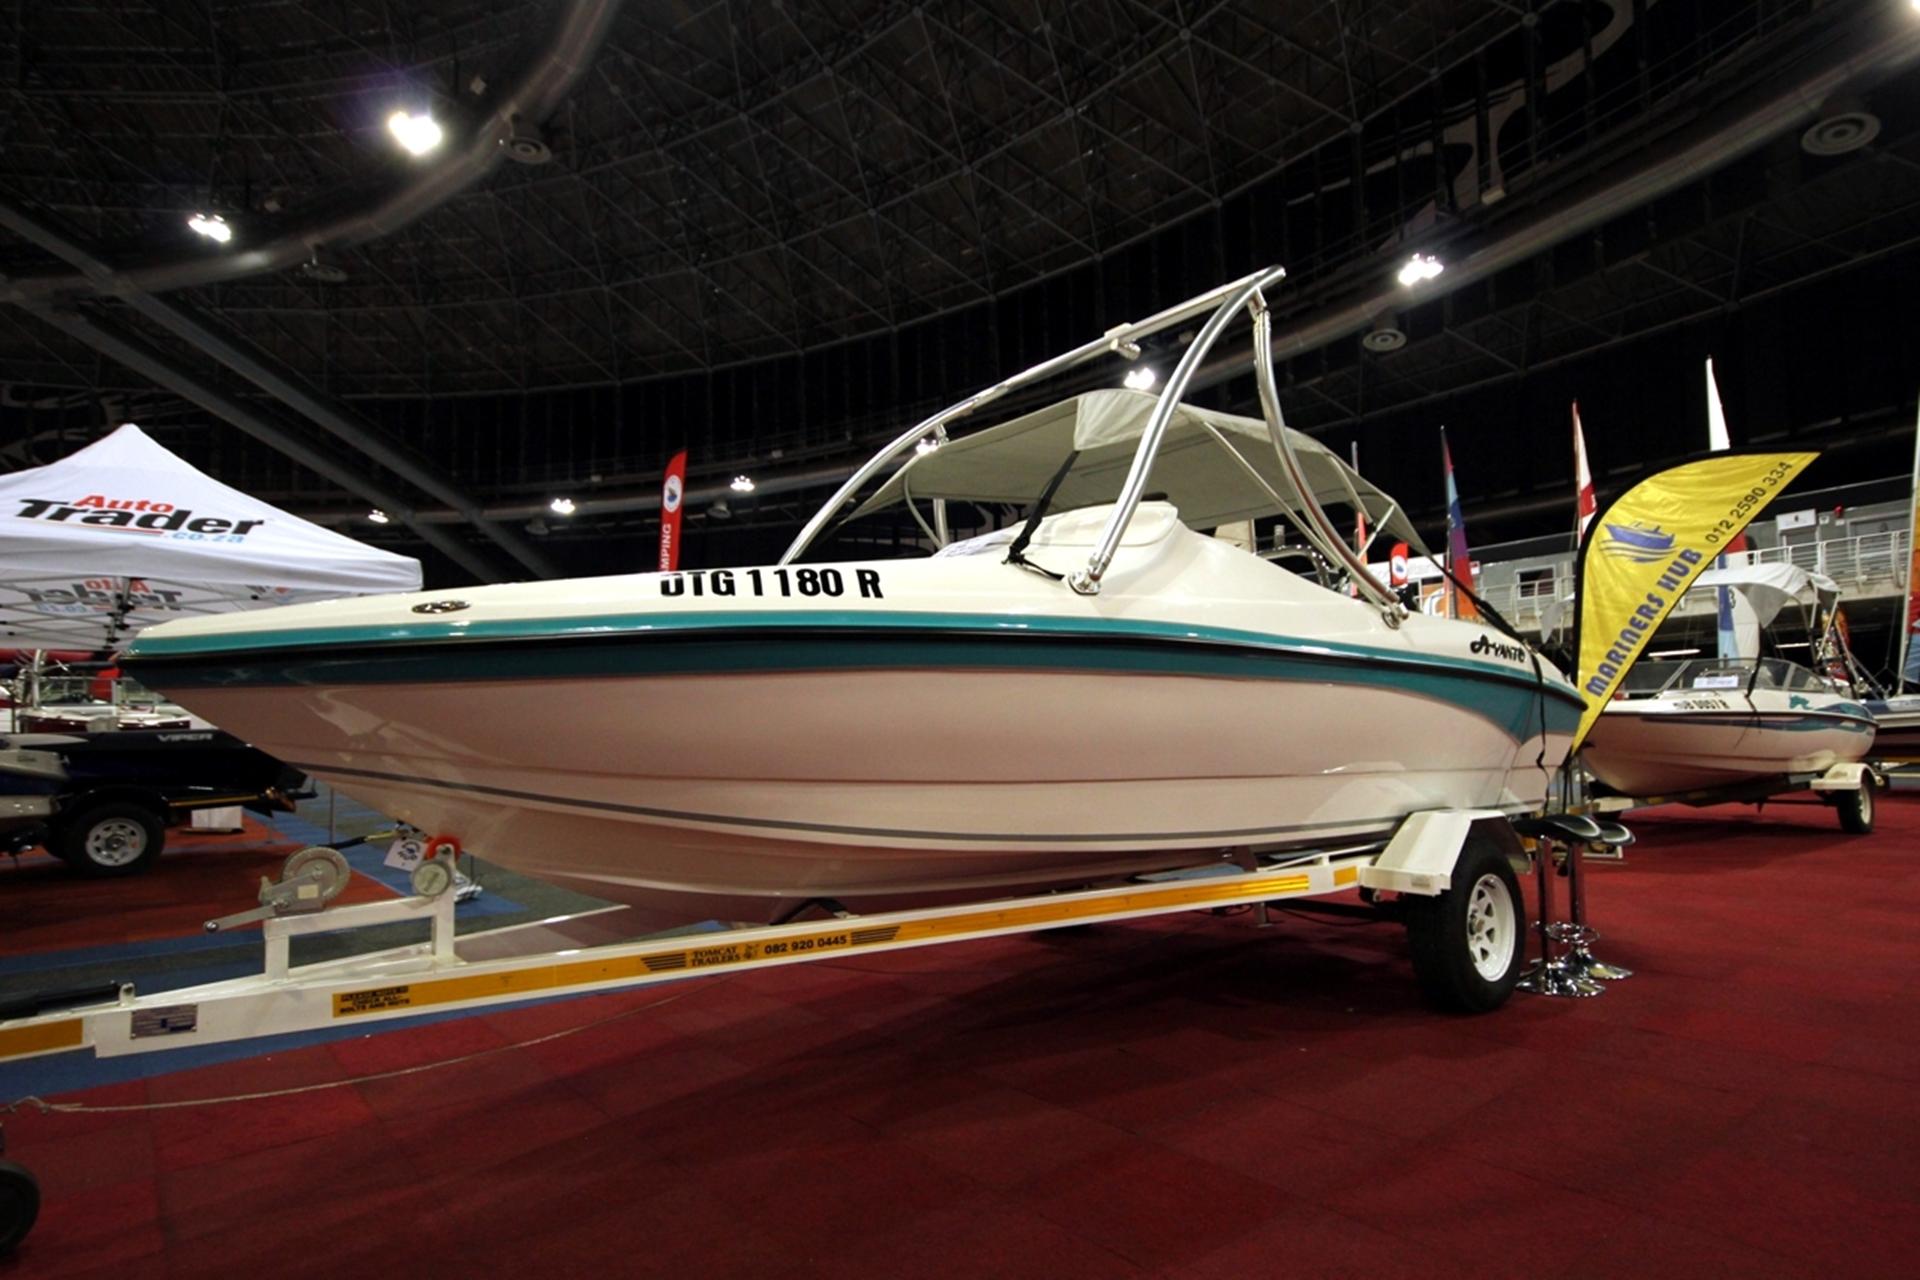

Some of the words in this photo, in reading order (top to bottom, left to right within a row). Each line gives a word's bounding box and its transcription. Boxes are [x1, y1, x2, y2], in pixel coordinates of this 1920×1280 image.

[74, 495, 174, 513] Auto
[1705, 519, 1734, 544] 012
[1730, 486, 1766, 519] 2590
[1763, 461, 1792, 486] 334
[16, 499, 264, 535] Trader
[856, 568, 883, 599] R
[1585, 593, 1665, 697] MARINERS
[1656, 548, 1703, 592] HUB
[693, 945, 737, 959] TOMCAT
[764, 943, 787, 954] 082
[792, 940, 814, 951] 920
[817, 935, 847, 948] 0445
[691, 954, 741, 967] TRAILERS
